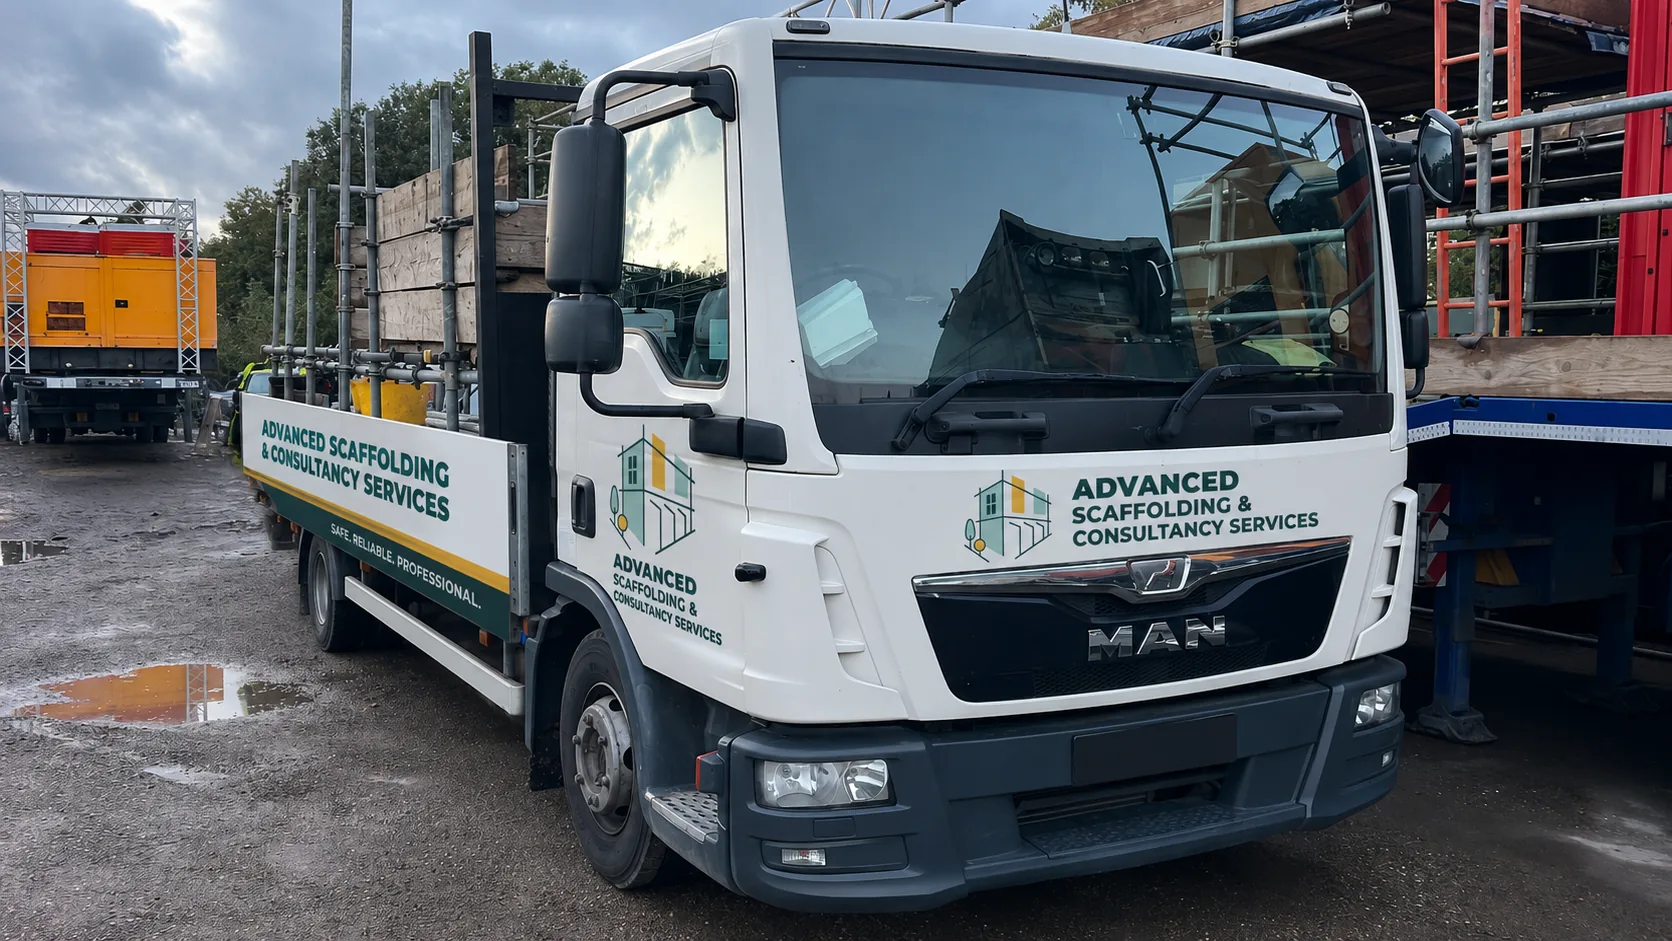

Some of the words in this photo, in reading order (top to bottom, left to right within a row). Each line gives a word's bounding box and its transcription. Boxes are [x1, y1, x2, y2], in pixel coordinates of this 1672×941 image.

[262, 419, 325, 452] ADVANCED
[329, 435, 450, 488] SCAFFOLDING
[261, 442, 269, 459] &
[271, 445, 360, 490] CONSULTANCY
[364, 473, 450, 522] SERVICES
[1072, 470, 1239, 500] ADVANCED
[1072, 497, 1231, 524] SCAFFOLDING
[1237, 495, 1251, 512] &
[1072, 519, 1224, 547] CONSULTANCY
[1229, 512, 1319, 534] SERVICES
[330, 523, 351, 542] SAFE.
[352, 534, 395, 564] RELIABLE.
[397, 555, 481, 609] PROFESSIONAL.
[613, 553, 697, 595] ADVANCED
[613, 572, 685, 612] SCAFFOLDING
[689, 601, 697, 617] &
[613, 590, 673, 624] CONSULTANCY
[675, 615, 722, 646] SERVICES
[1087, 615, 1226, 662] MAN
